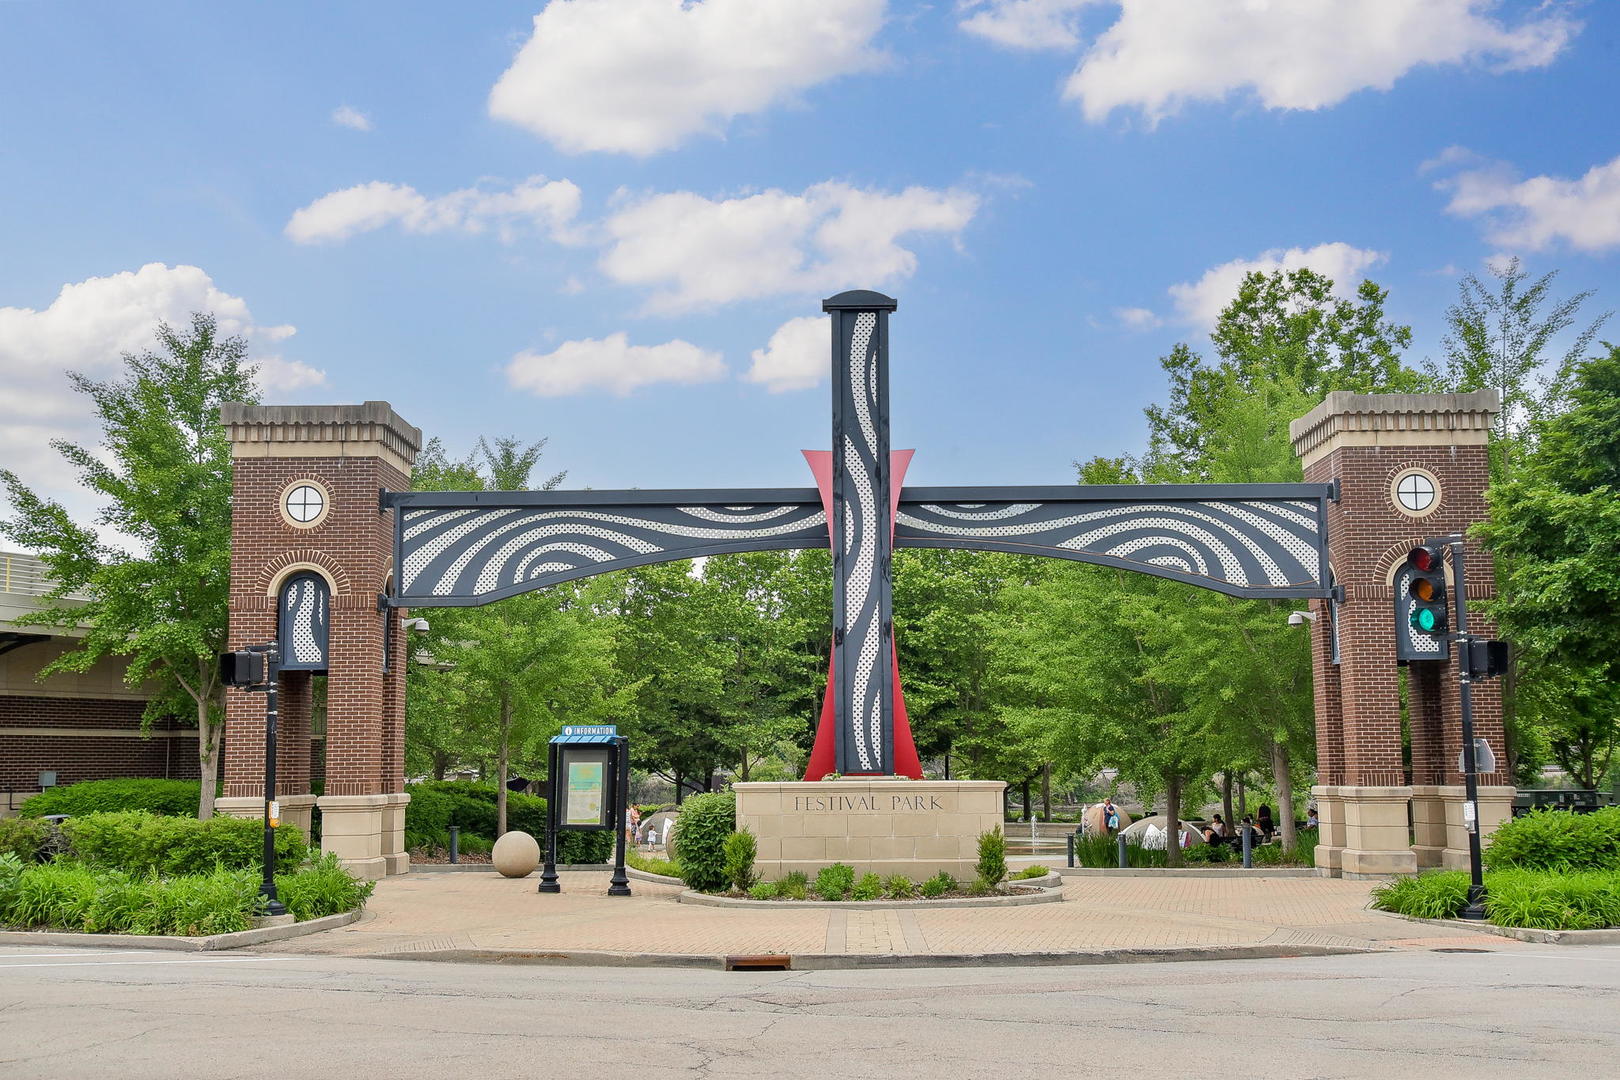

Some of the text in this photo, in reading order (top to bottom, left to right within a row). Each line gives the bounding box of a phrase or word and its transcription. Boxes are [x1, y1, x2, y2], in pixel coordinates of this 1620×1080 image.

[573, 727, 614, 735] INFORMATION
[795, 795, 944, 811] FESTIVAL PARK
